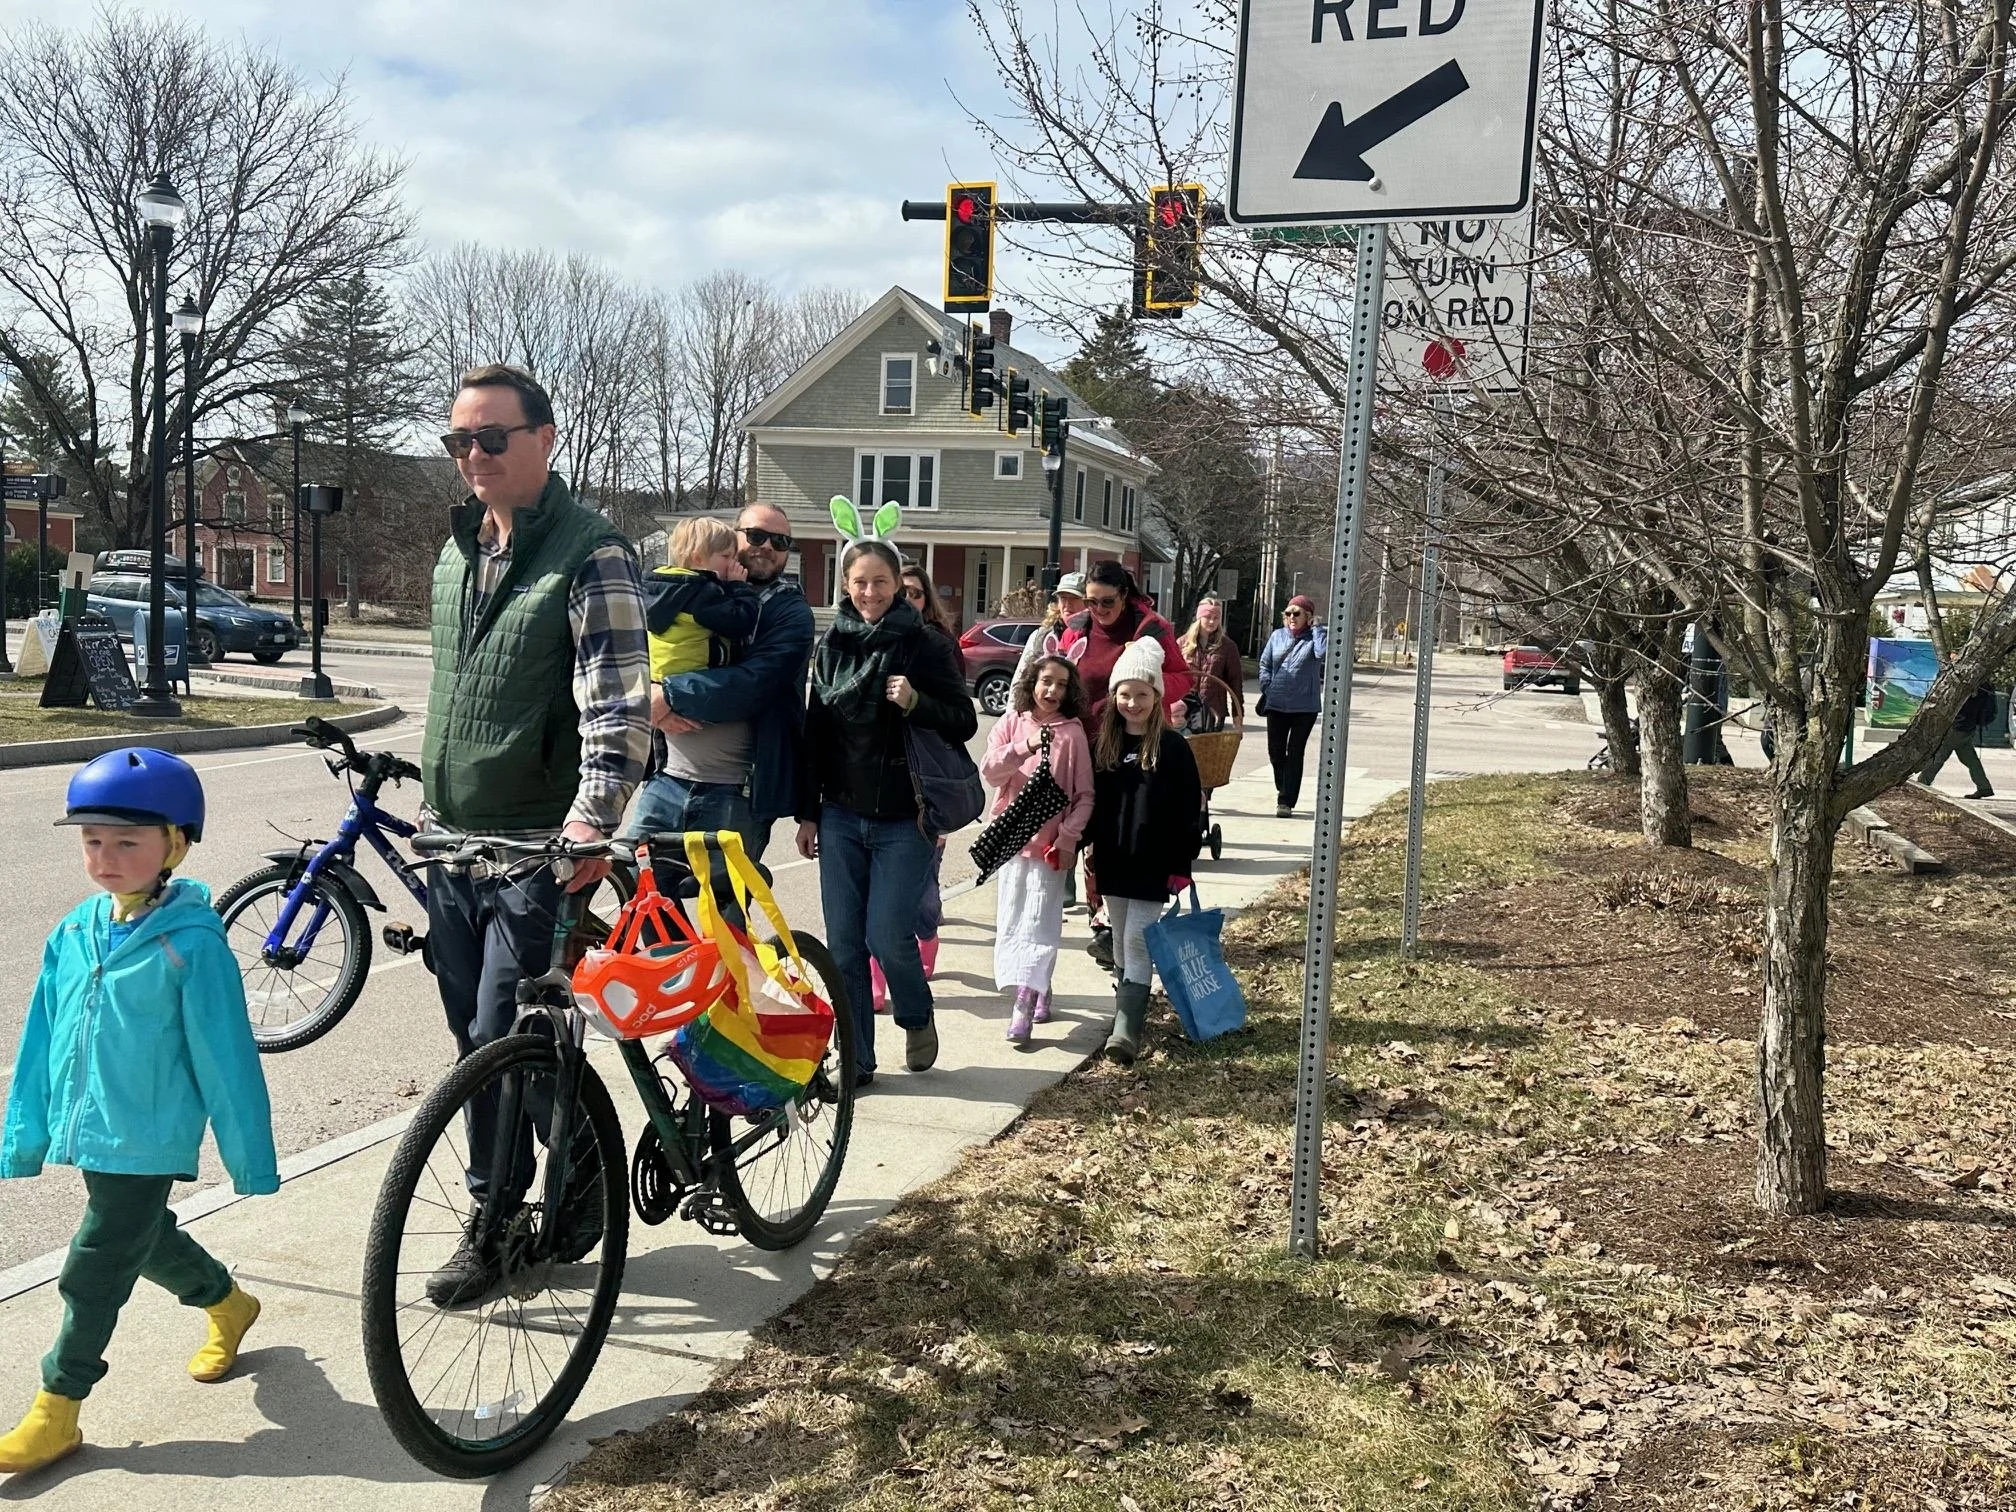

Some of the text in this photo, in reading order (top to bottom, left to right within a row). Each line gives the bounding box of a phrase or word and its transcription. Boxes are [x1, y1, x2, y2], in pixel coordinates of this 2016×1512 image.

[1311, 0, 1466, 43] RED
[1421, 220, 1486, 245] NO
[1408, 255, 1496, 287] TURN
[1383, 296, 1514, 329] ON RED
[1178, 939, 1200, 962] little
[1181, 954, 1212, 985] BLUE
[1189, 973, 1223, 1001] HOUSE
